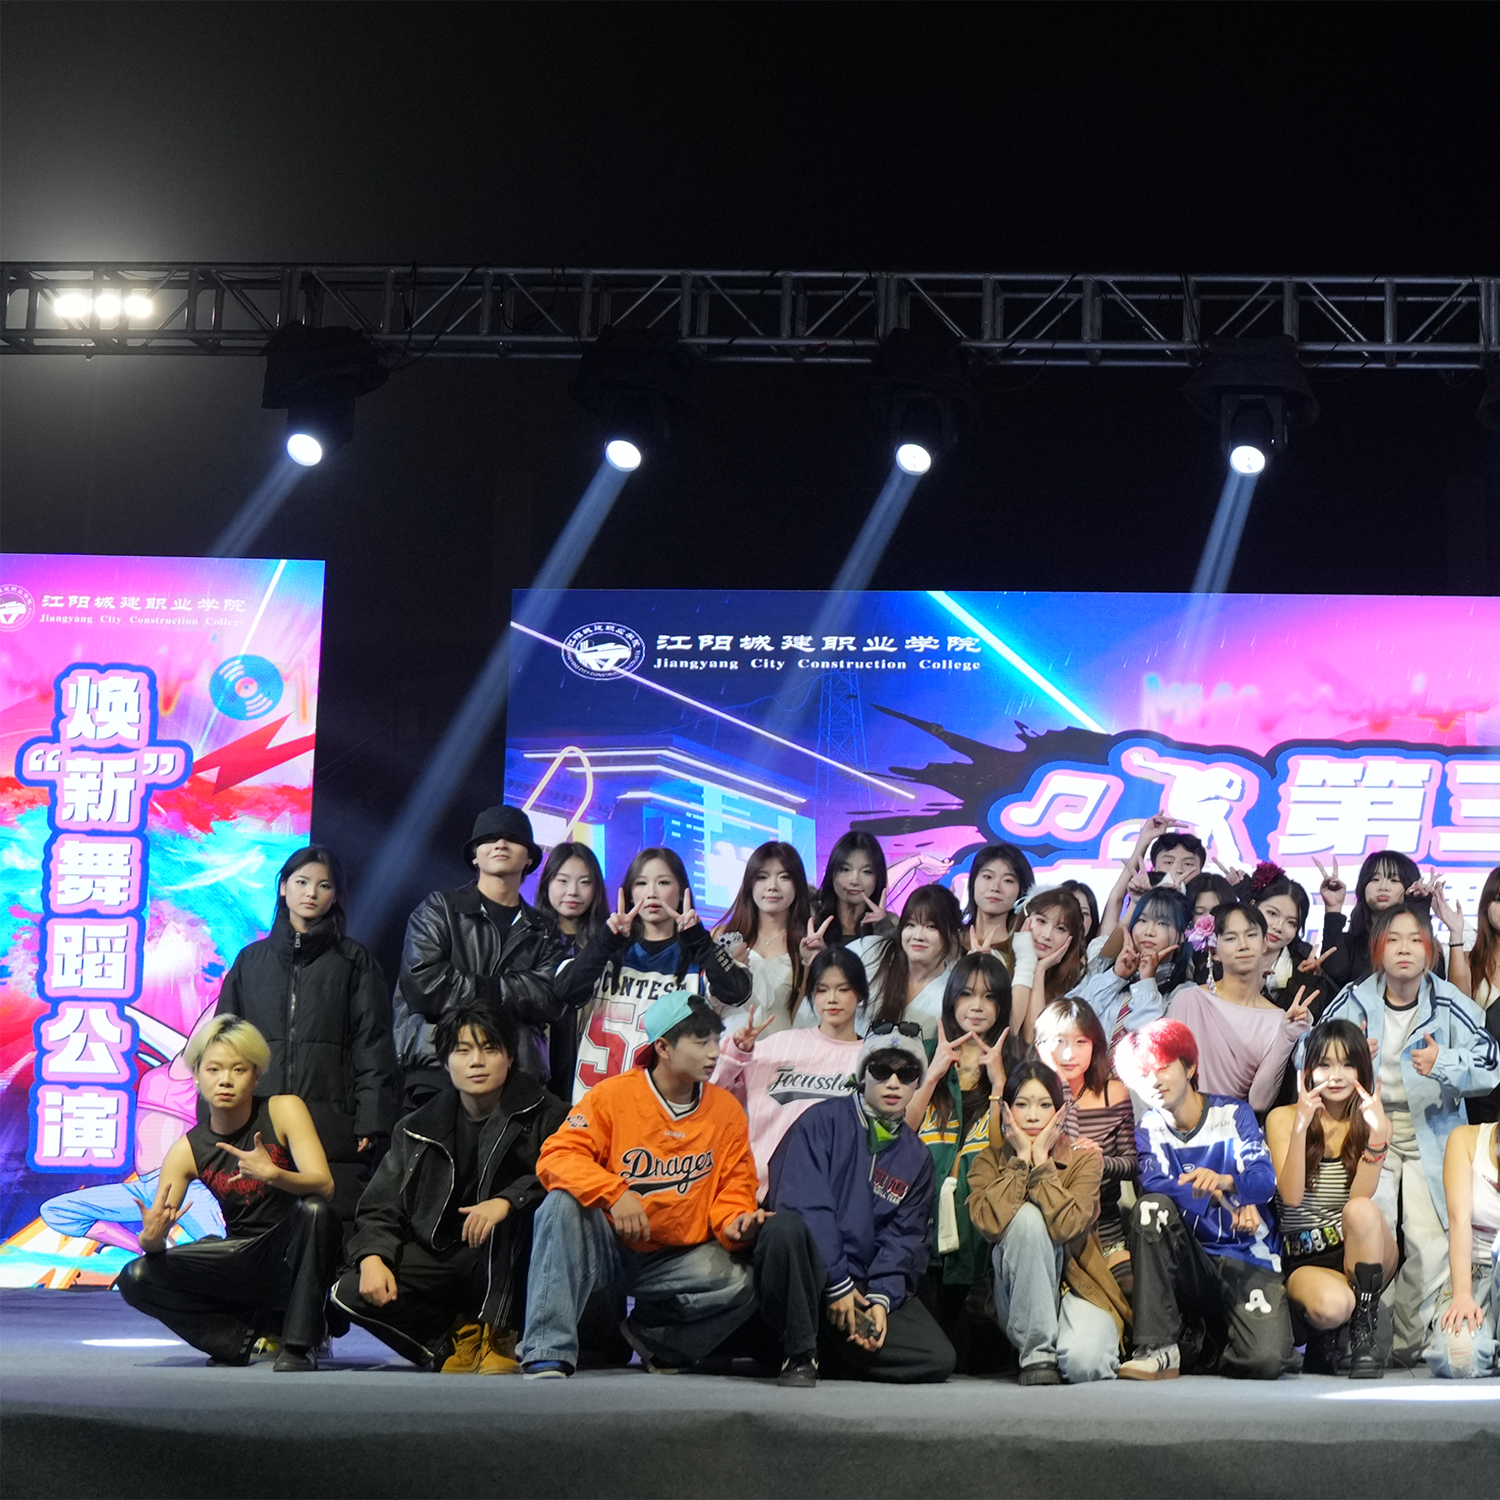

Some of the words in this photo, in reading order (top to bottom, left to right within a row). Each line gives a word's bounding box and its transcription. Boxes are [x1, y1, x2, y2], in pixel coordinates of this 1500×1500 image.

[42, 594, 246, 613] 江阳城建职业学院
[39, 613, 93, 625] Jiangyang
[100, 614, 122, 626] City
[129, 615, 198, 626] Construction
[206, 616, 245, 627] College
[656, 634, 982, 654] 江阳城建职业学院
[653, 656, 739, 673] Jiangyang
[750, 656, 785, 672] City
[797, 657, 907, 671] Construction
[918, 657, 981, 673] College
[601, 970, 687, 1000] CNTES
